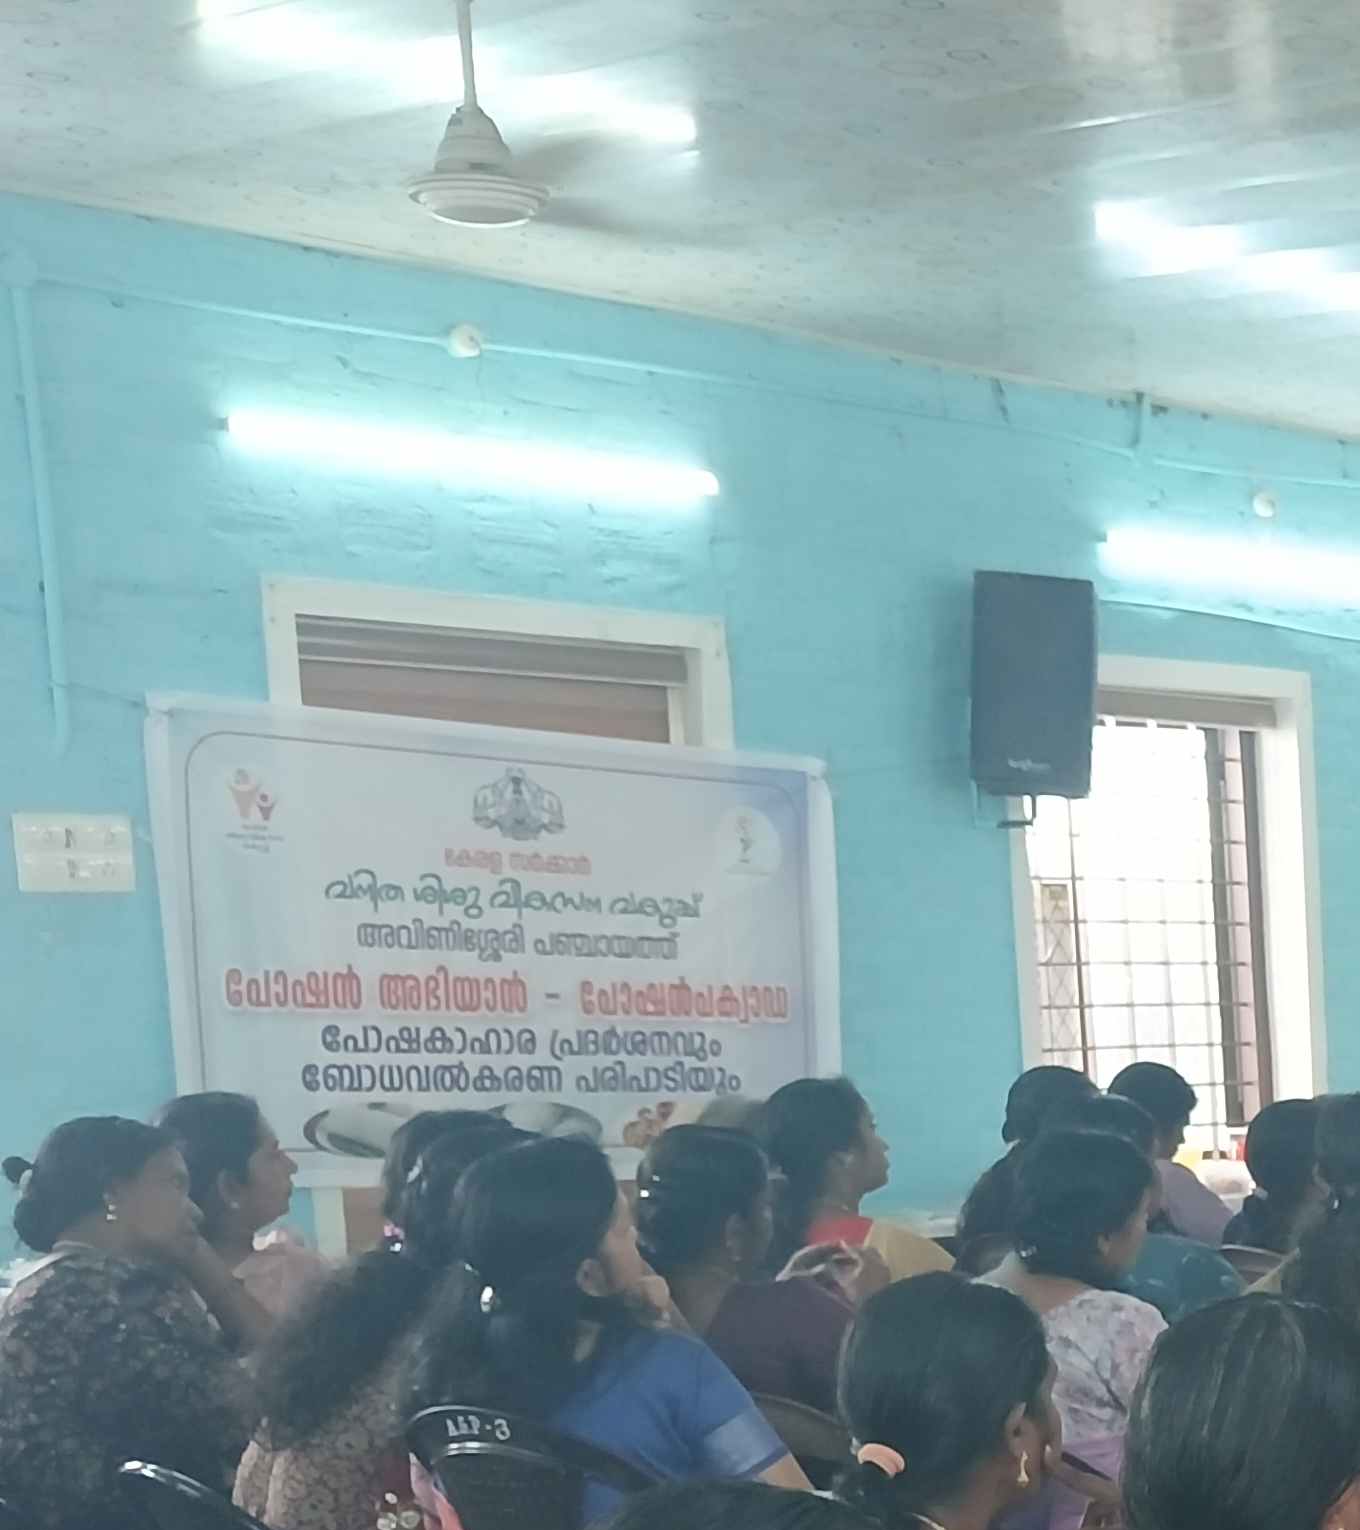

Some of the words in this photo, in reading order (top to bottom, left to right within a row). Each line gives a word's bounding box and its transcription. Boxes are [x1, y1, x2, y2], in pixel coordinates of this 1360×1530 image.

[224, 964, 363, 1010] പോഷൻ
[378, 964, 529, 1013] അഭിയാൻ
[321, 1024, 537, 1057] പോഷകാഹാര
[550, 1025, 723, 1062] പ്രദർശനവും
[575, 1060, 742, 1095] പരിപാടിയും
